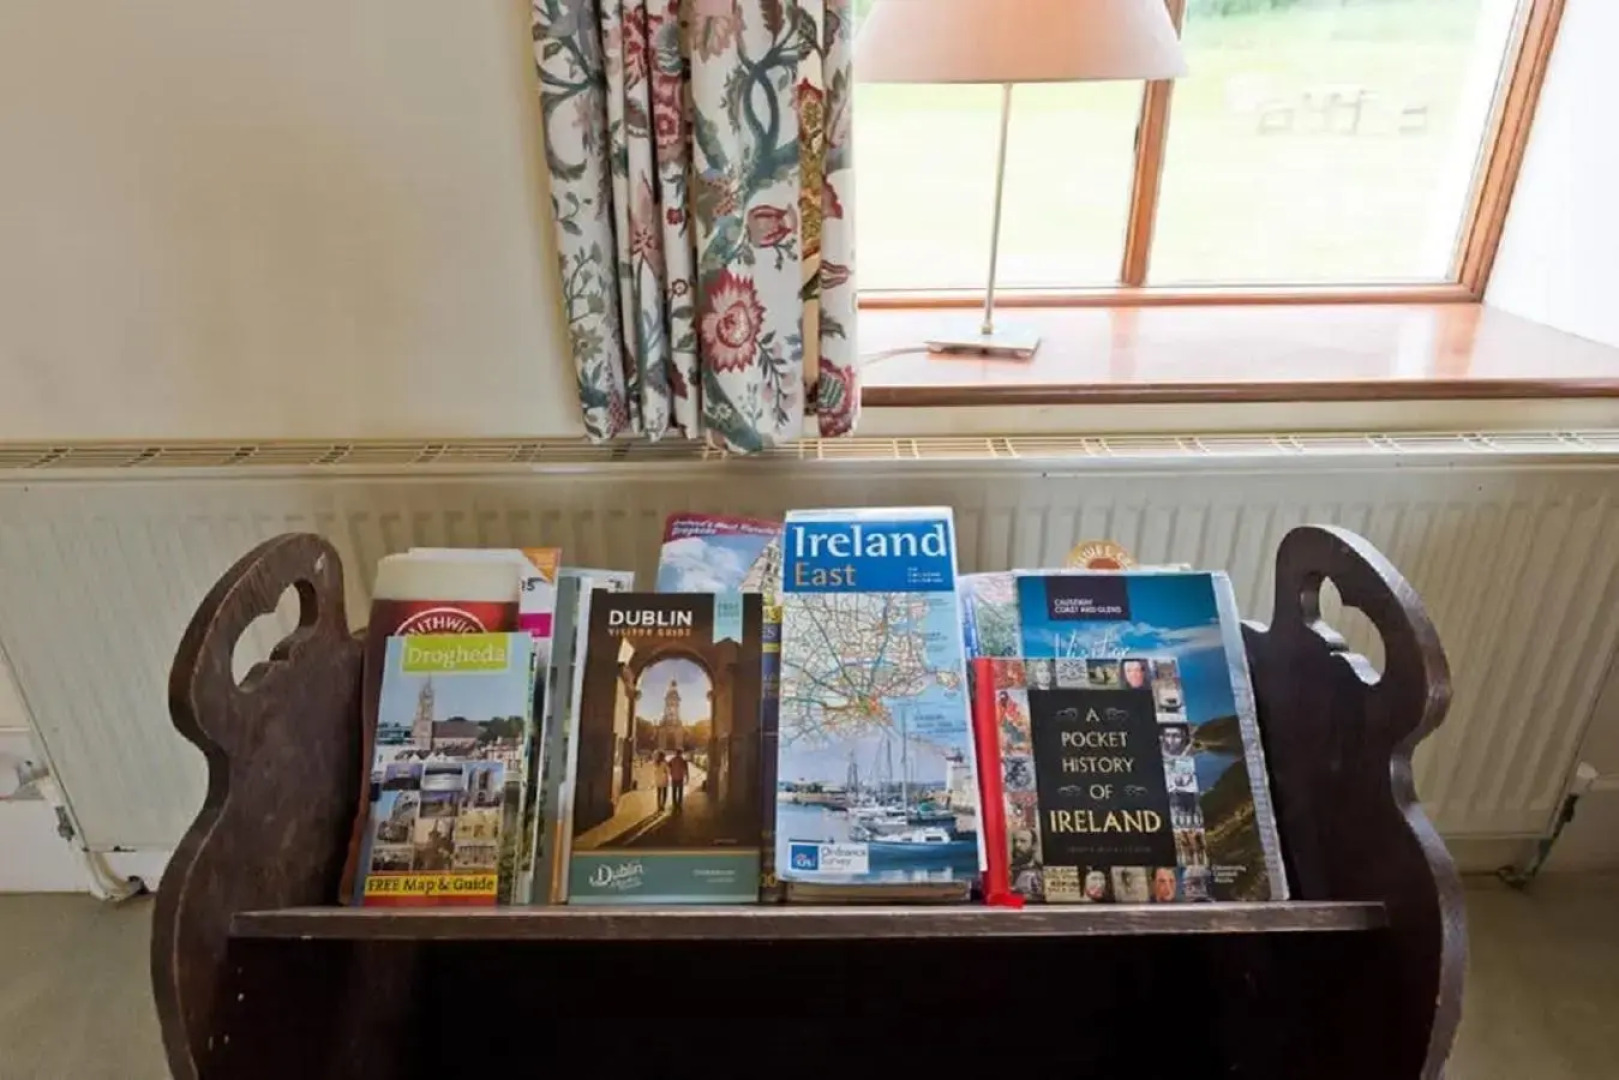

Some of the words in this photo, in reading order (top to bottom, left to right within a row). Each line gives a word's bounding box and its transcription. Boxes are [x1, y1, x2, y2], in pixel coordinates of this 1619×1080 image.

[792, 524, 947, 557] Ireland
[795, 561, 856, 586] East
[608, 610, 693, 626] DUBLIN
[407, 644, 506, 669] Drogheda
[1086, 707, 1100, 722] A
[1061, 731, 1128, 748] POCKET
[1062, 757, 1134, 773] HISTORY
[1089, 784, 1114, 800] OF
[1049, 809, 1162, 833] IRELAND
[368, 879, 400, 892] FREE
[402, 879, 436, 896] Map
[438, 879, 449, 890] &
[453, 877, 494, 890] Guide
